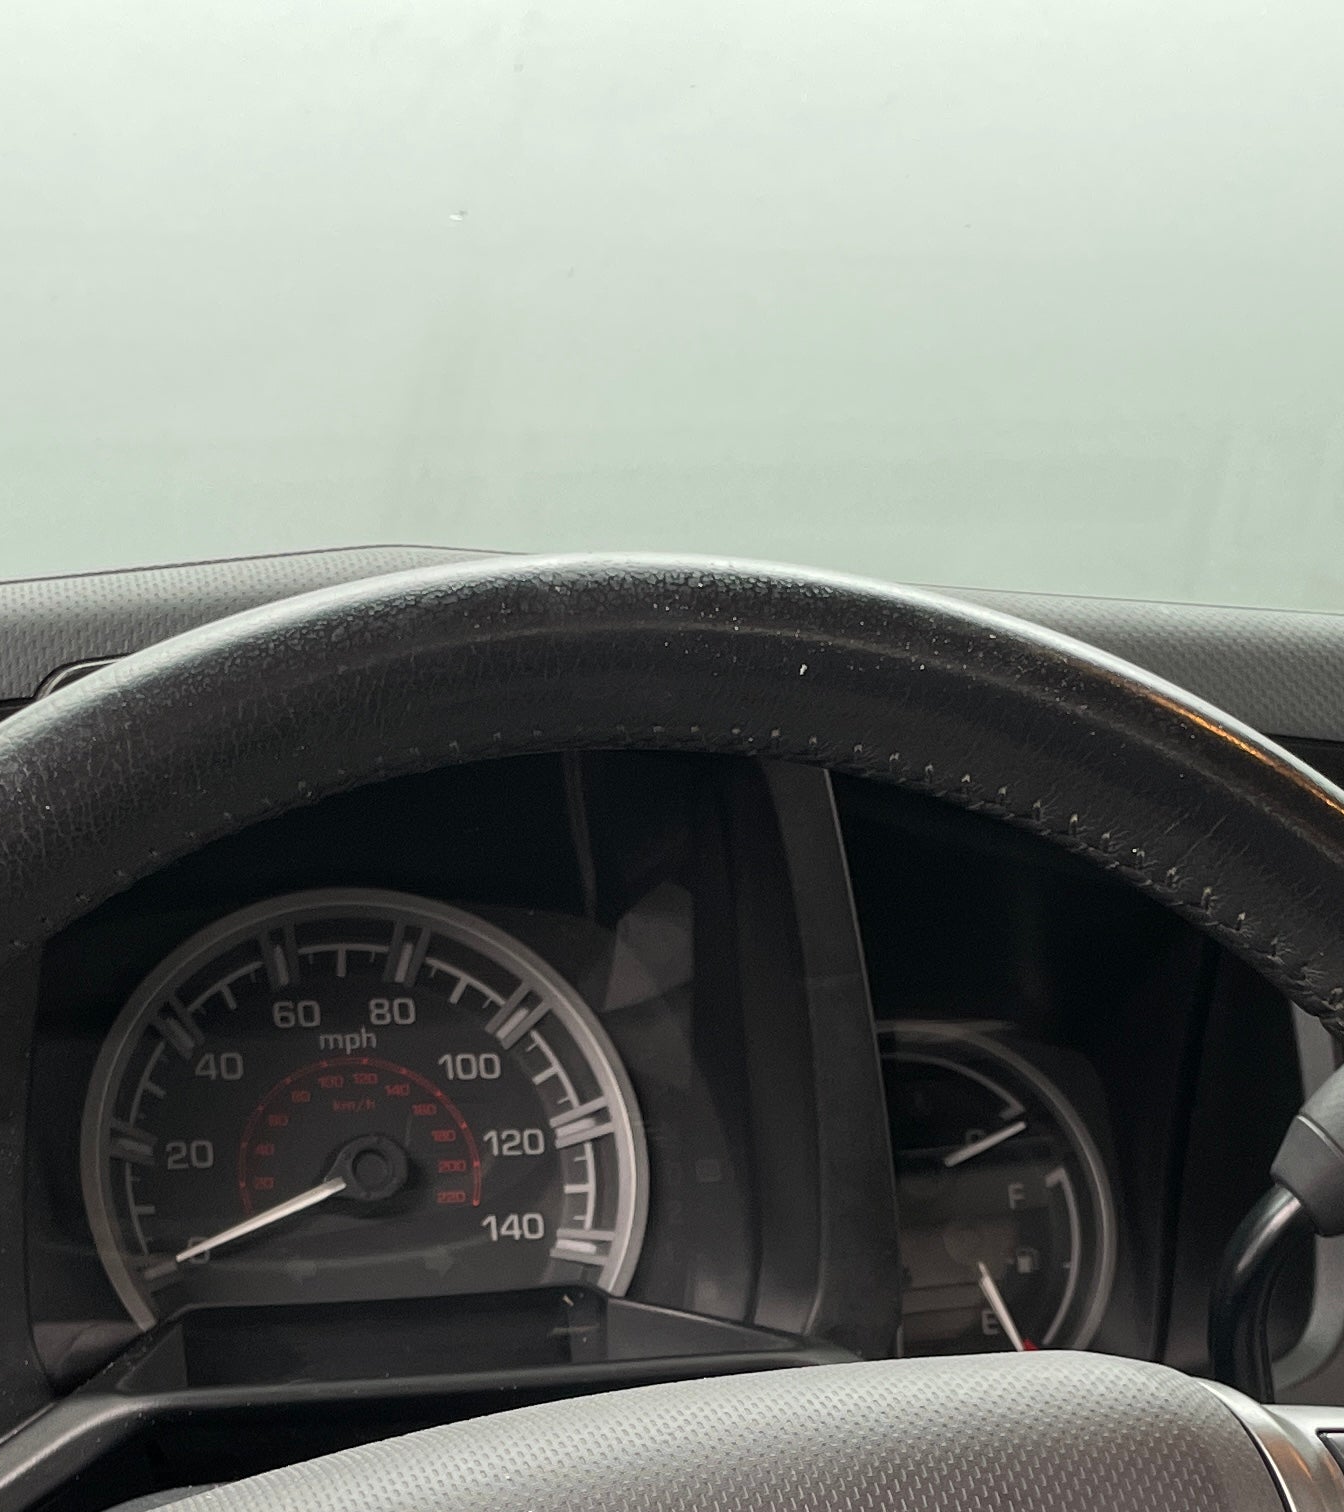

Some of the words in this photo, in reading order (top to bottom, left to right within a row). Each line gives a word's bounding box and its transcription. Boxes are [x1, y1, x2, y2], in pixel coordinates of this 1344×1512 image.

[272, 1000, 321, 1029] 60
[367, 998, 416, 1026] 80
[318, 1026, 377, 1055] mph
[195, 1052, 244, 1081] 40
[437, 1051, 502, 1081] 100
[165, 1140, 214, 1169] 20
[482, 1128, 545, 1158] 120
[1007, 1182, 1026, 1210] F
[481, 1212, 545, 1241] 140
